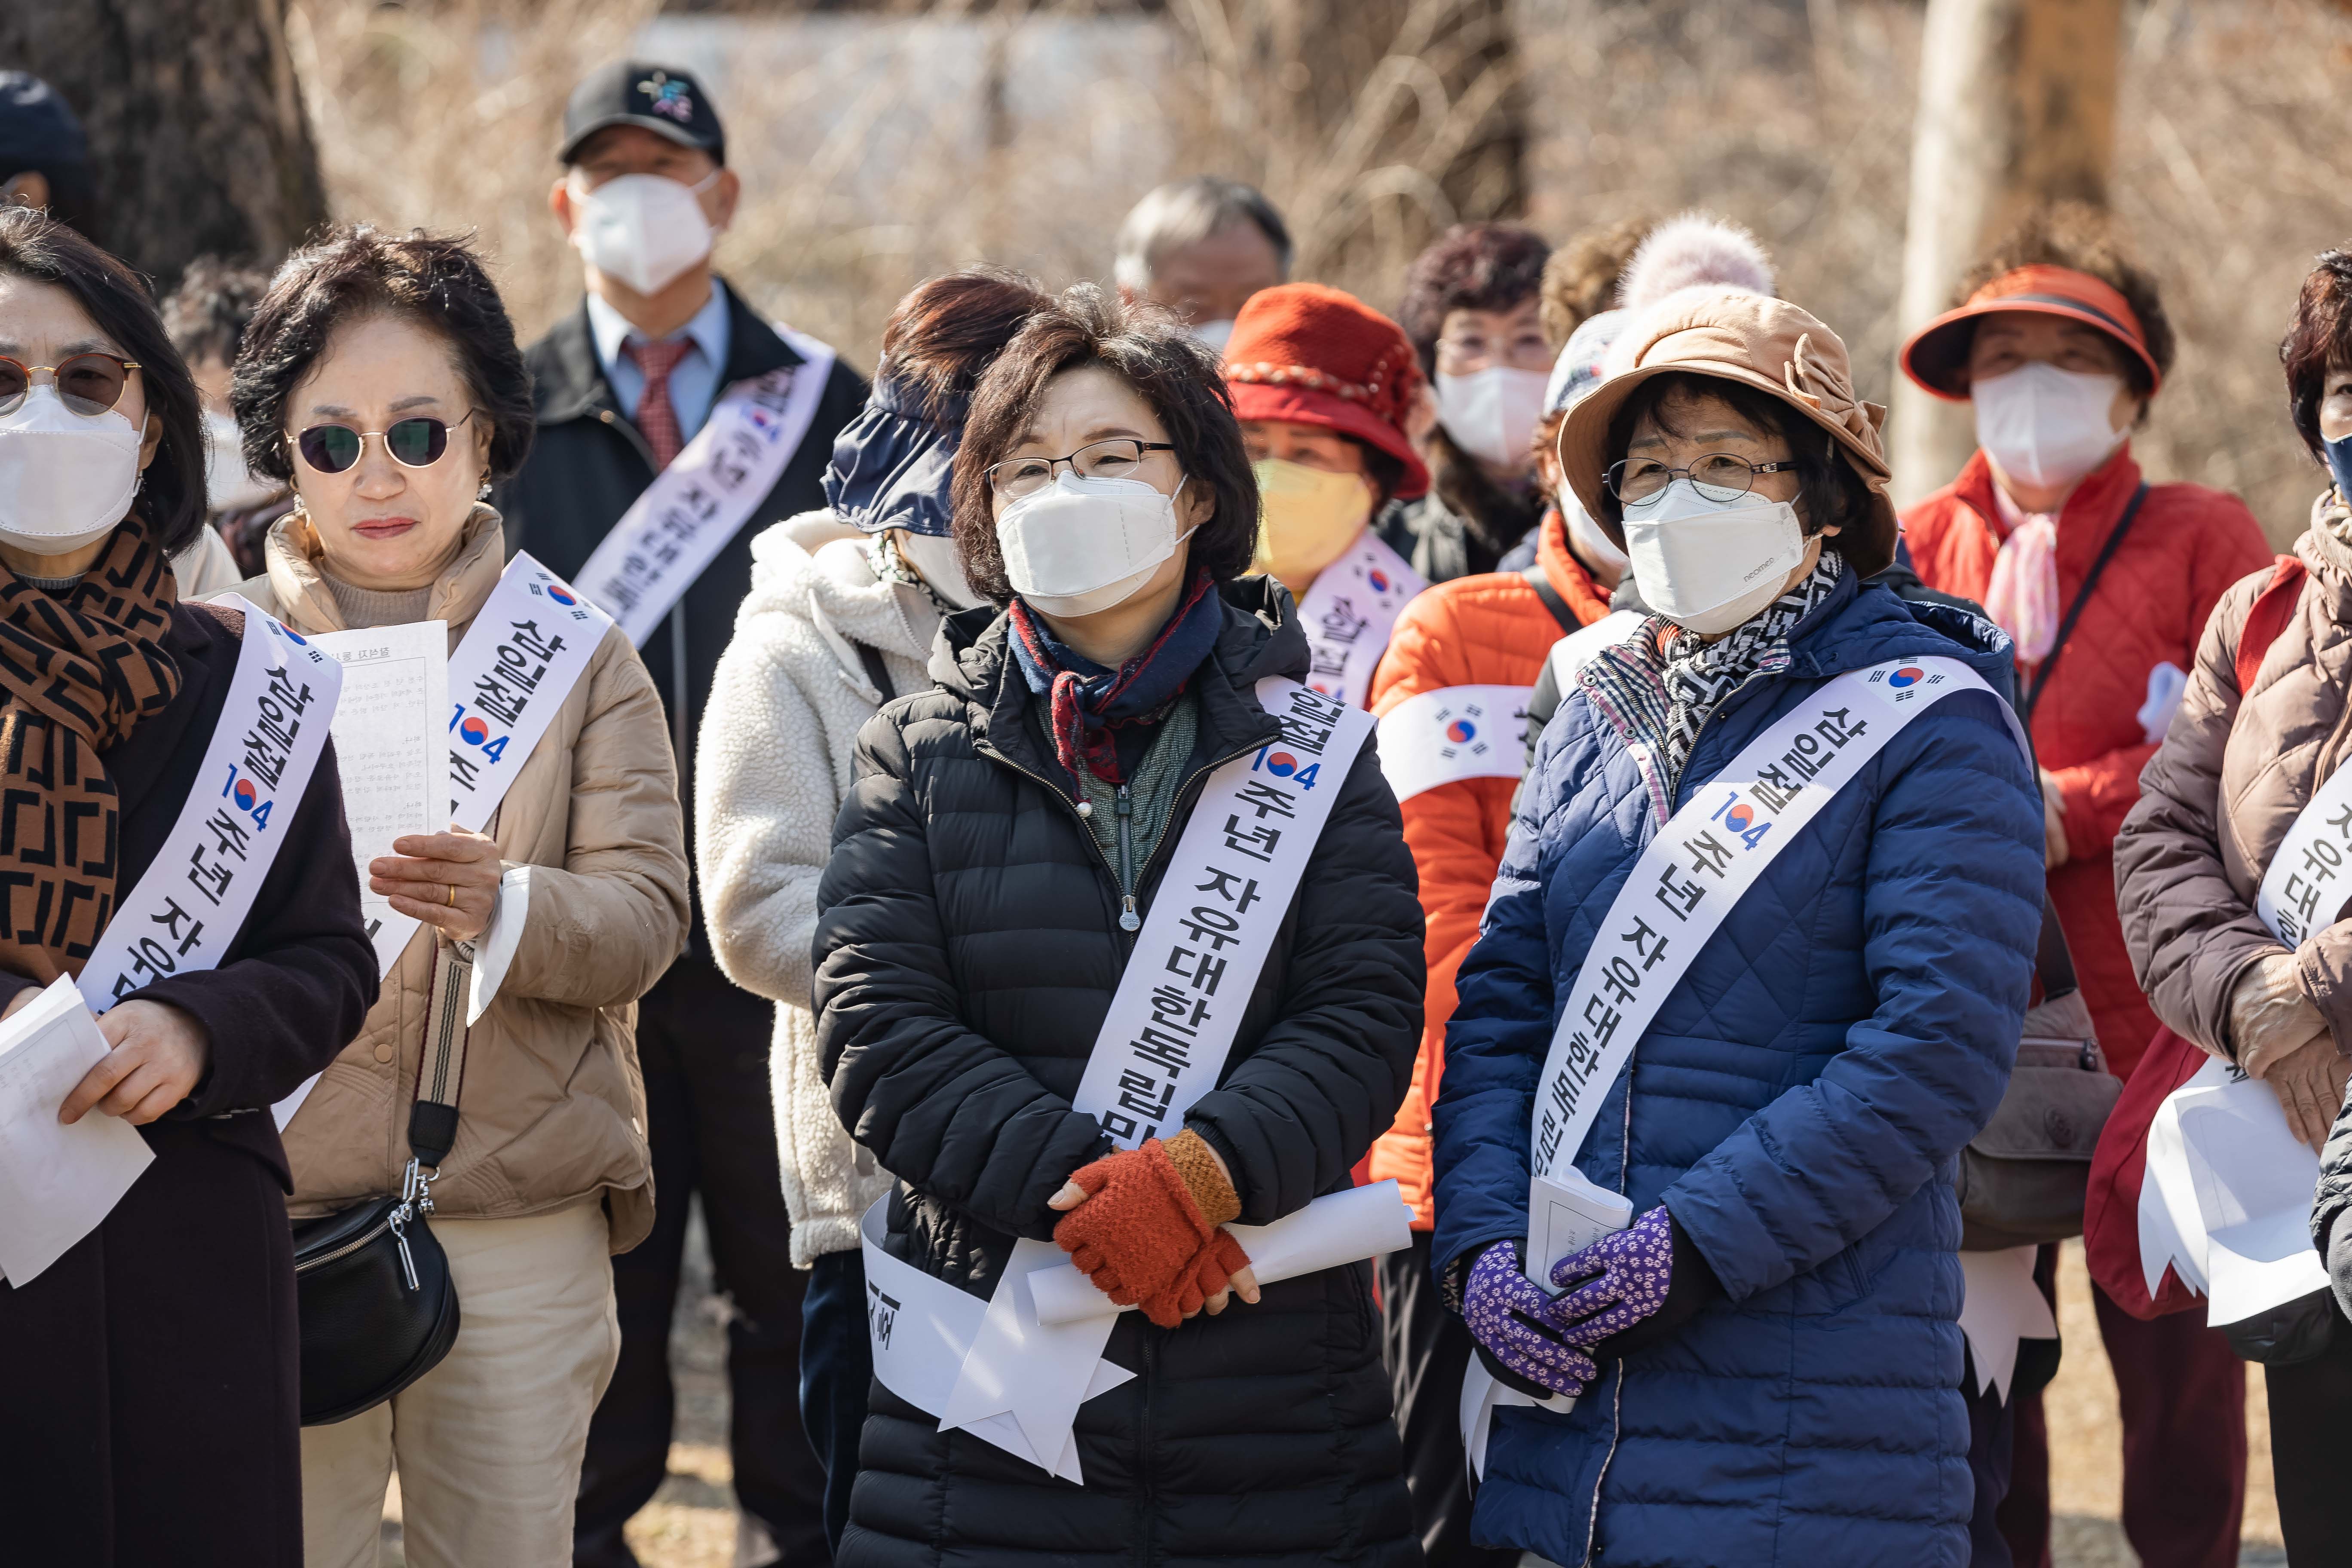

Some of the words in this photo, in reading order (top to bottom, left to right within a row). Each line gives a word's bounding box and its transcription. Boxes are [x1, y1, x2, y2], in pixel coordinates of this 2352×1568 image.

[473, 619, 567, 728] 삼일절
[242, 665, 315, 793] 삼일절
[1749, 707, 1868, 815] 삼일절
